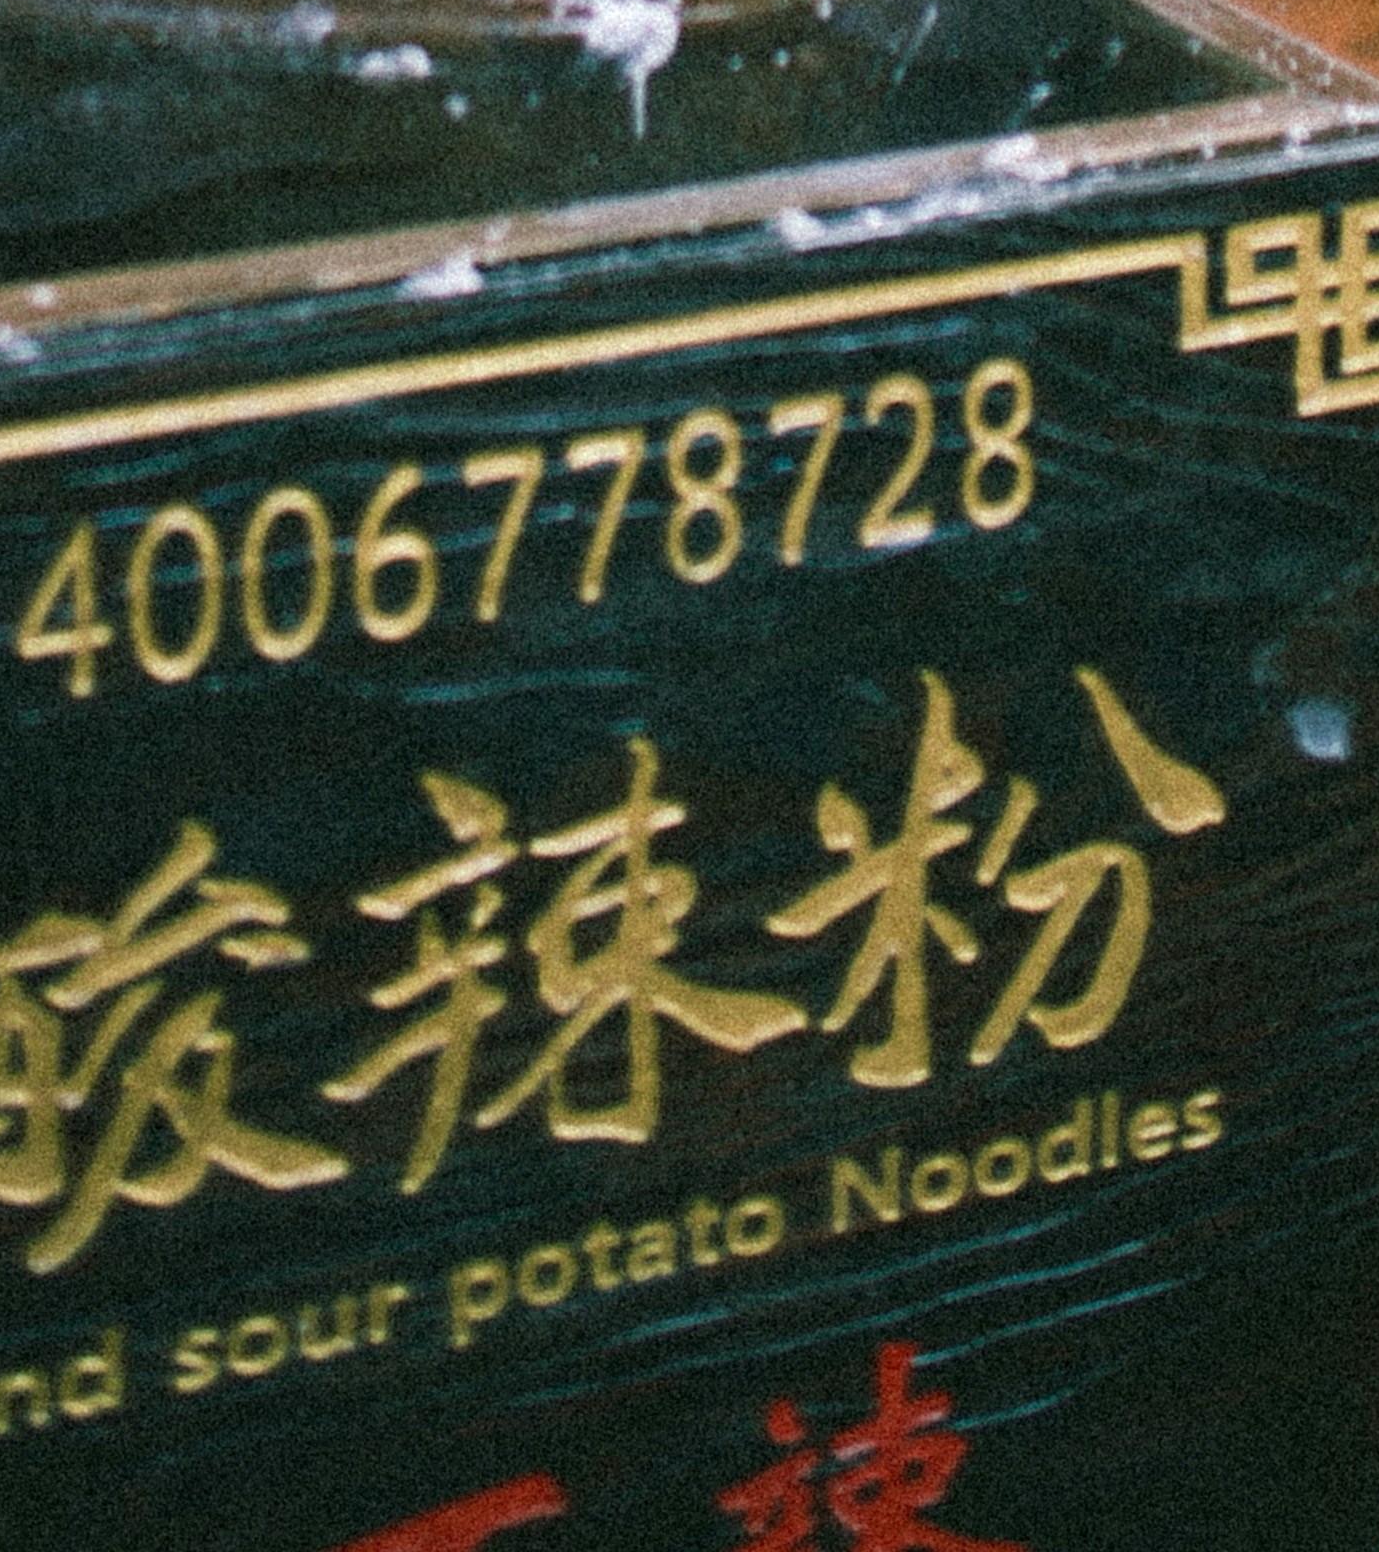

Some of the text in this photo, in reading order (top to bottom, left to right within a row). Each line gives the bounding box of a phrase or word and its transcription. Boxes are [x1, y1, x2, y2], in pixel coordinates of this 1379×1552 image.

[16, 356, 1035, 698] 4006778728
[173, 1284, 412, 1395] sour
[448, 1192, 786, 1350] potato
[829, 1088, 1224, 1234] Noodles
